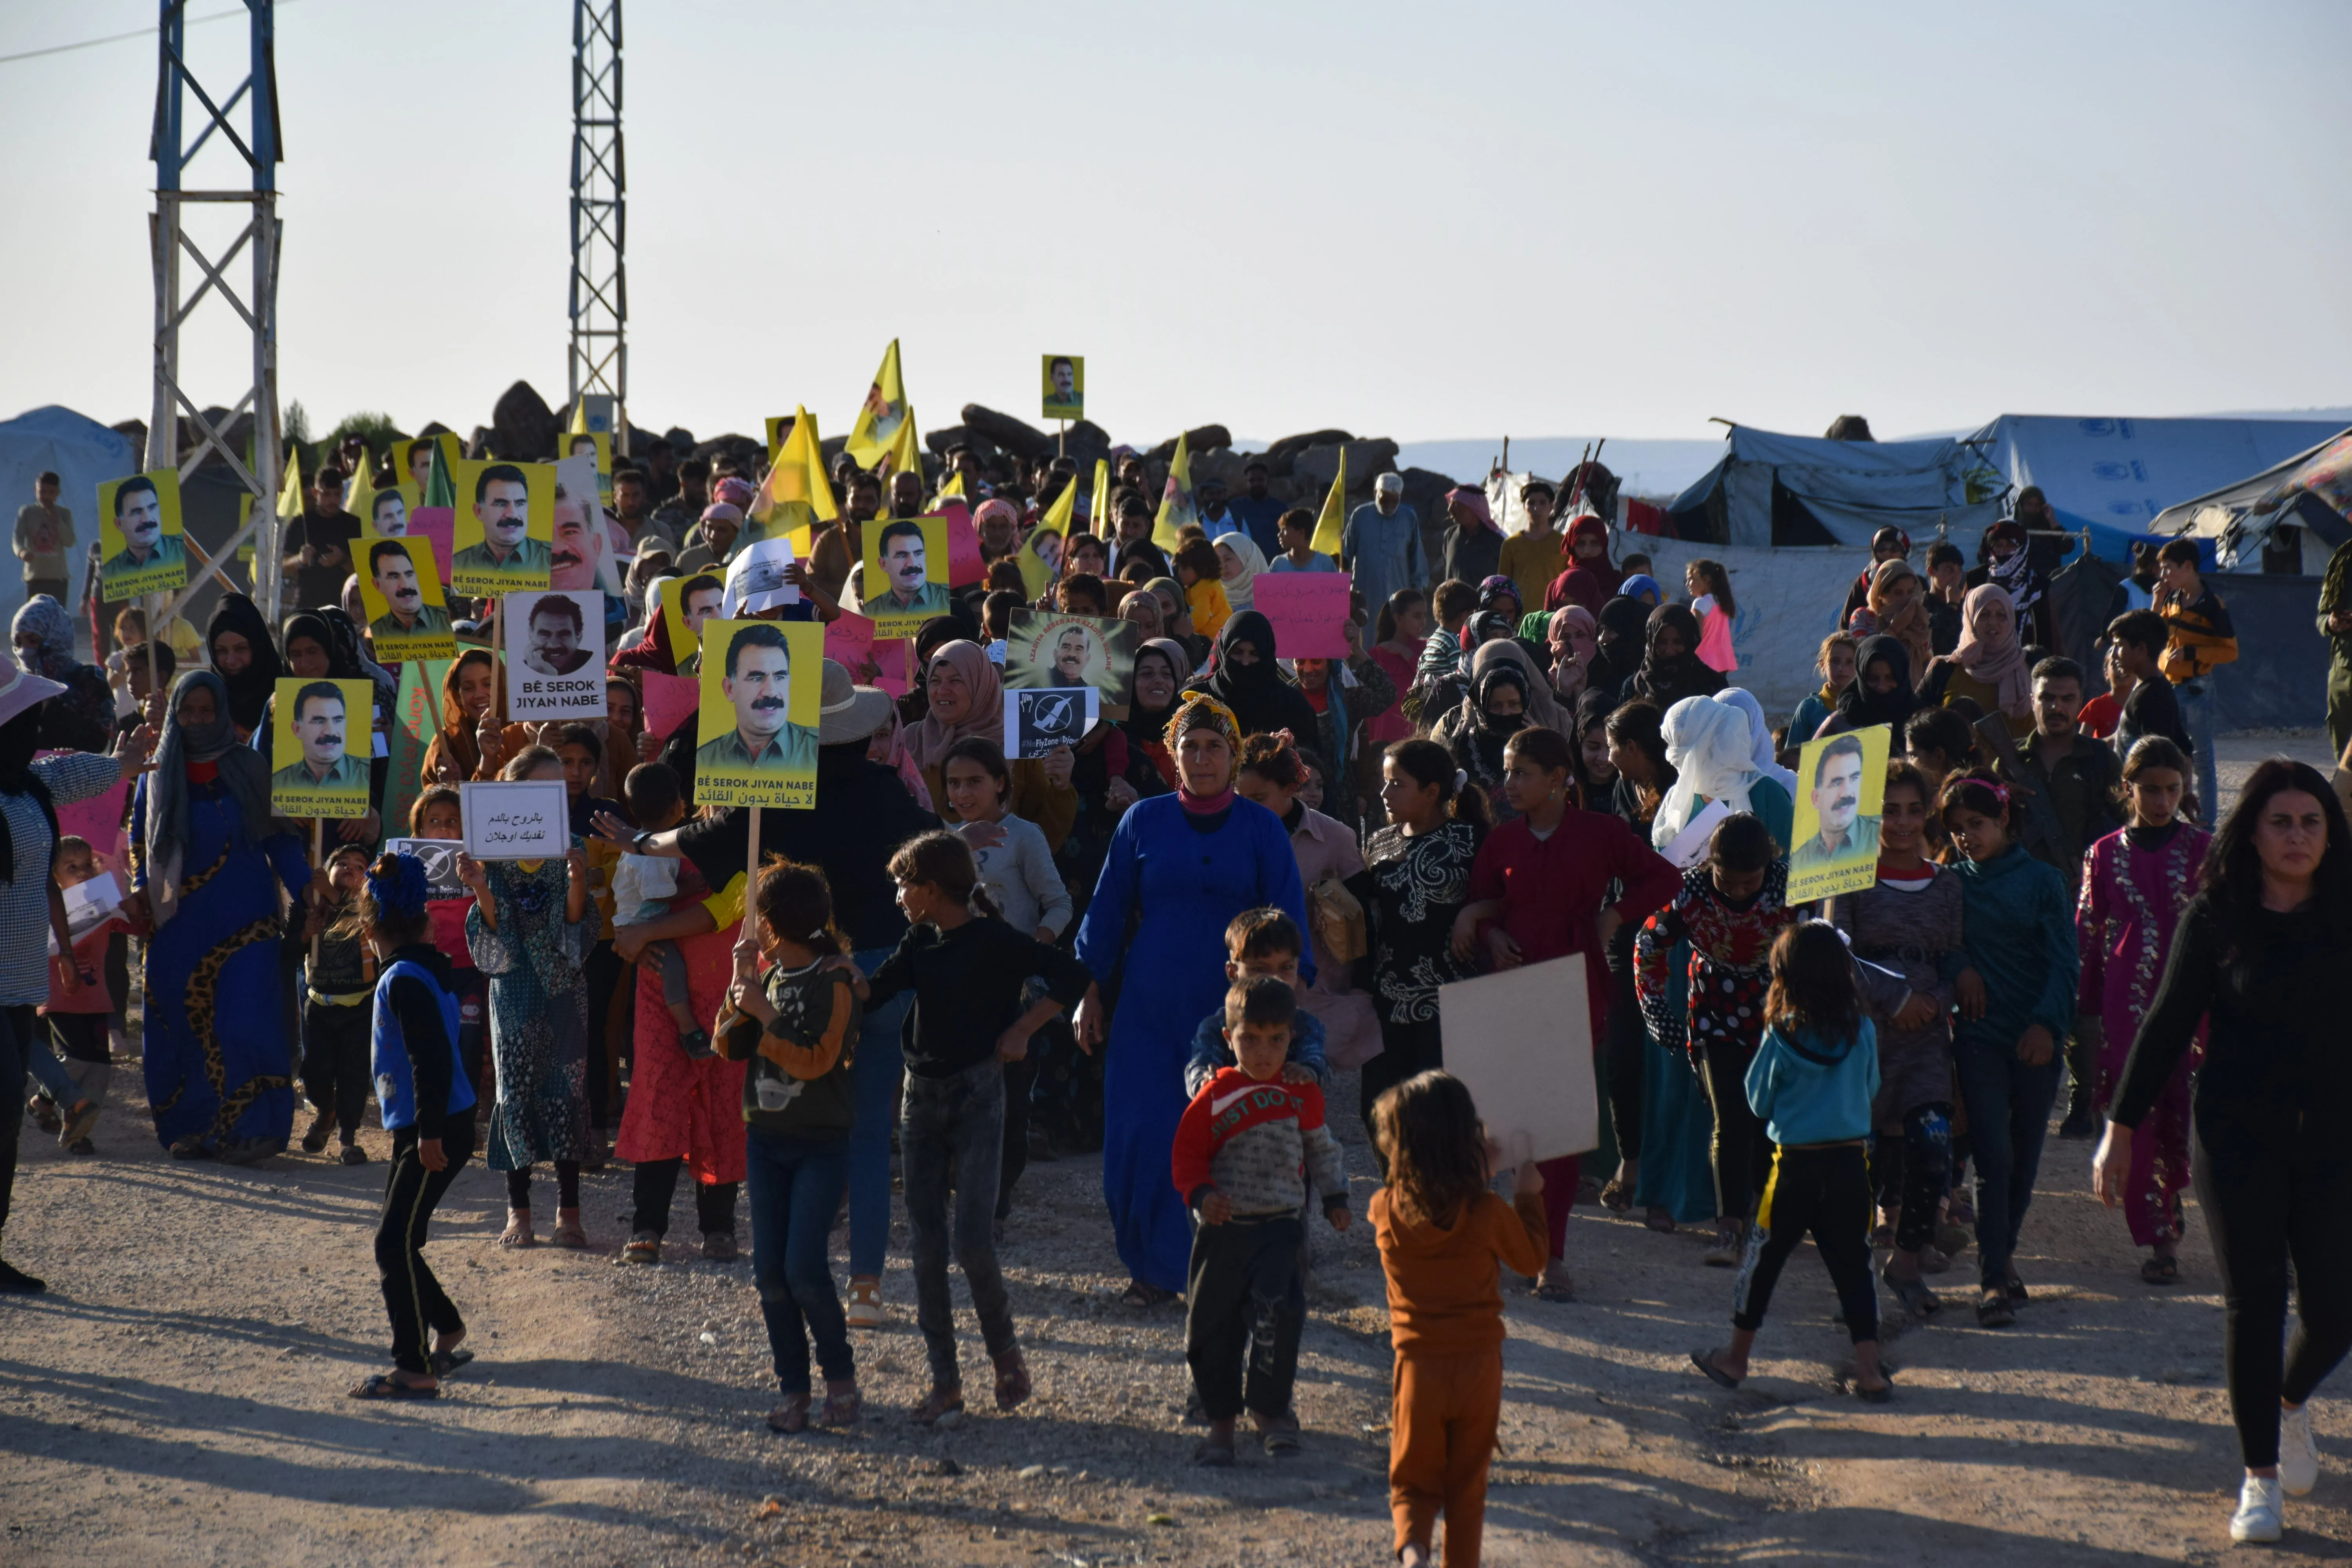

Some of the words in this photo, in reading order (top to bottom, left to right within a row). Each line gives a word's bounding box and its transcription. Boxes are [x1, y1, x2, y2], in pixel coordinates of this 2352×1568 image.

[114, 578, 140, 588] SEROK
[141, 573, 163, 583] JIYAN
[165, 569, 185, 578] NABE
[453, 574, 463, 583] BÊ
[466, 577, 494, 585] SEROK
[376, 642, 384, 651] BÊ
[379, 650, 402, 660] القائد
[405, 653, 426, 661] بدون
[430, 650, 448, 660] حياة
[523, 680, 543, 693] BÊ
[546, 681, 595, 692] SEROK
[516, 697, 557, 708] JIYAN
[561, 695, 599, 707] NABE
[698, 775, 710, 786] BÊ
[713, 778, 748, 788] SEROK
[751, 780, 783, 789] JIYAN
[786, 781, 814, 790] NABE
[273, 794, 283, 802] BÊ
[698, 789, 733, 801] القائد
[739, 792, 769, 806] بدون
[775, 792, 800, 807] حياة
[806, 793, 812, 804] لا
[306, 805, 330, 817] بدون
[335, 806, 356, 817] حياة
[488, 813, 509, 826] بالدم
[512, 813, 543, 826] بالروح
[485, 831, 517, 843] اوجلان
[520, 830, 545, 842] نفديك
[1800, 874, 1825, 886] SEROK
[1826, 868, 1850, 880] JIYAN
[1853, 863, 1875, 874] NABE
[1843, 878, 1863, 890] حياة
[1212, 1100, 1249, 1140] JUST
[1252, 1091, 1285, 1109] DO
